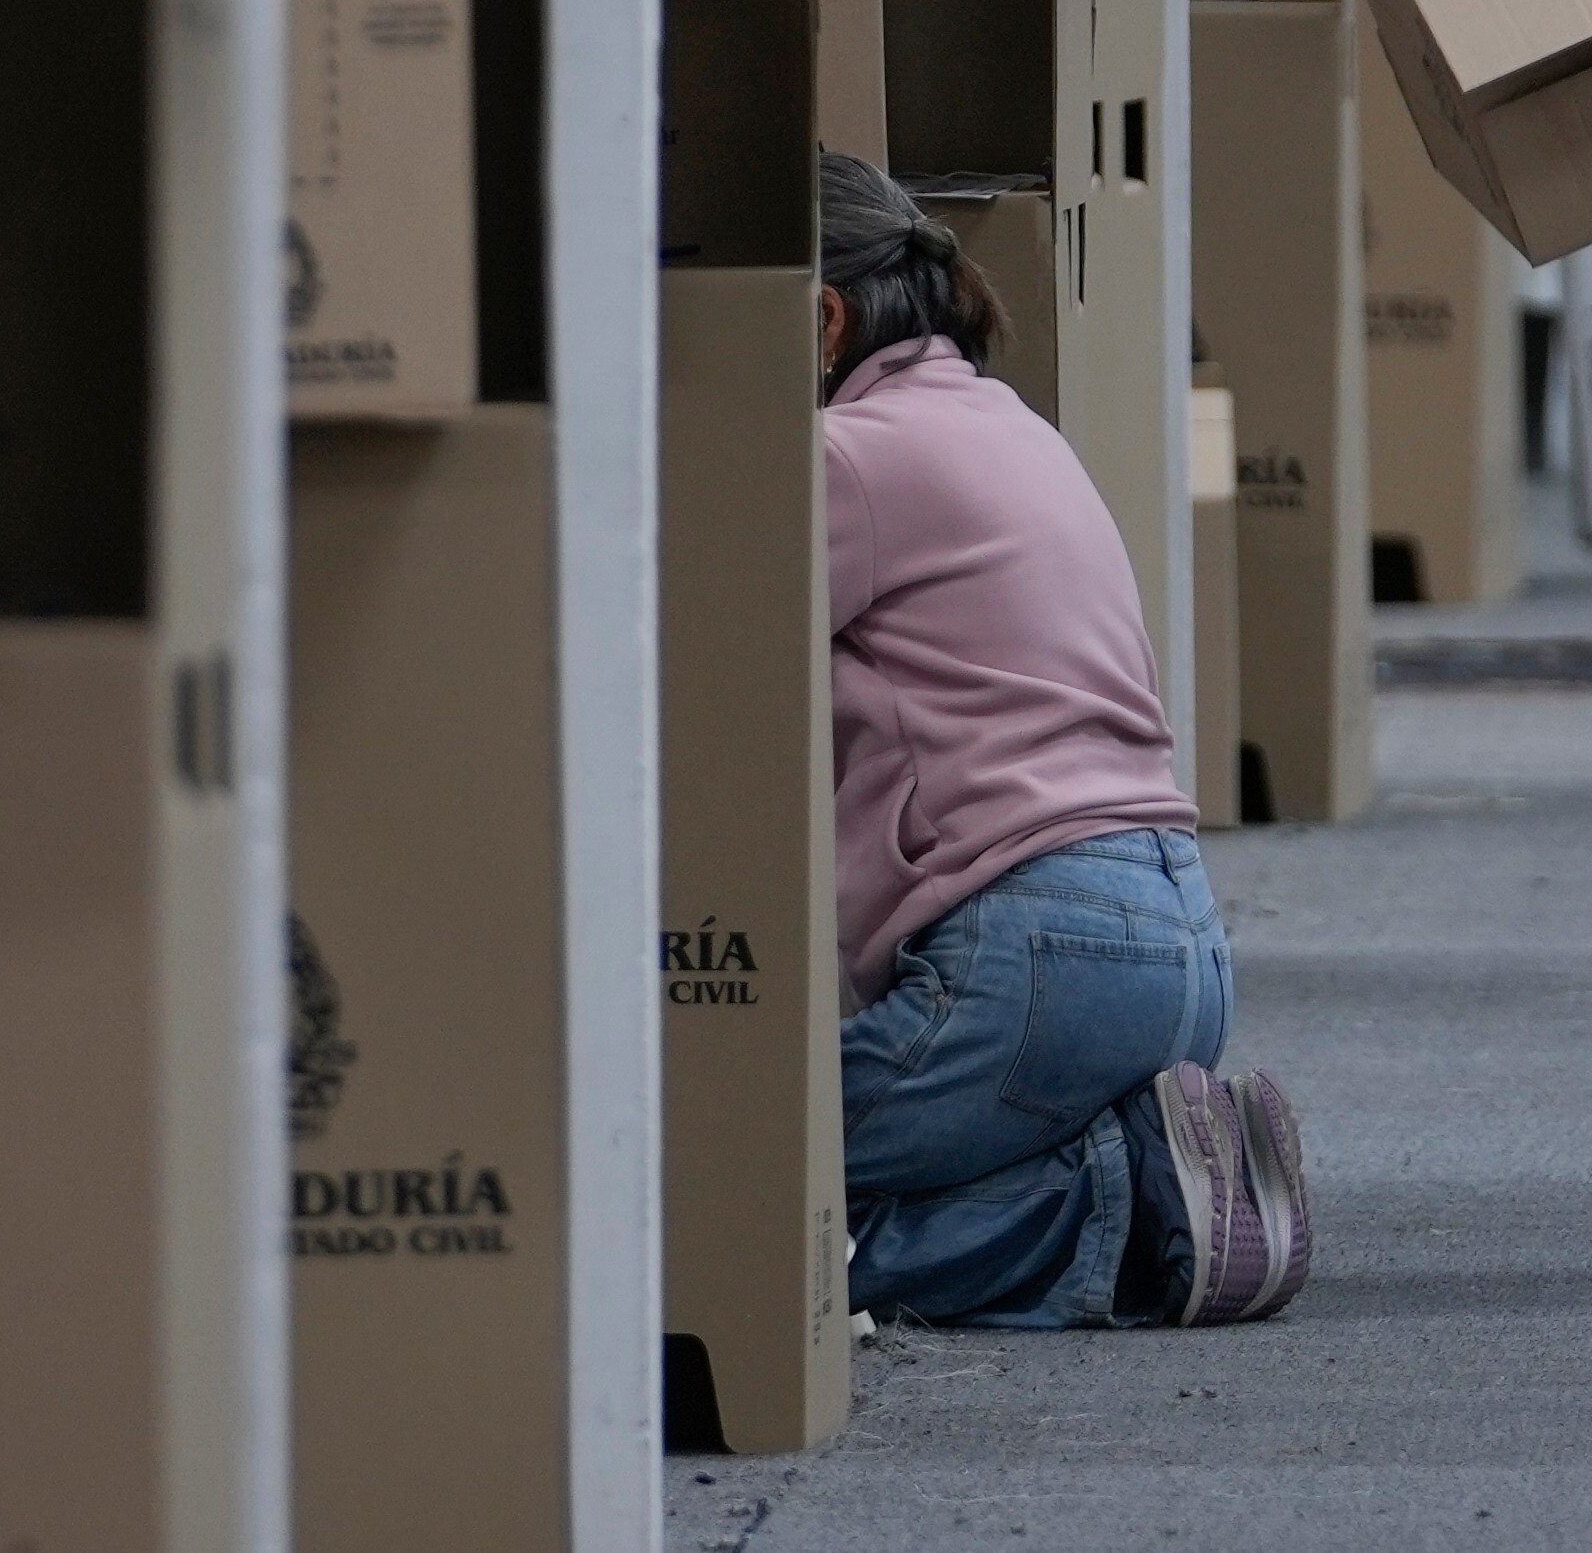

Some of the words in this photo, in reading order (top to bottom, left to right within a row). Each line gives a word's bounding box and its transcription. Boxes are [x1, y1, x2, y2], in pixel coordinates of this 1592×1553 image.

[659, 915, 760, 972] RÍA
[668, 980, 760, 1005] CIVIL
[290, 1148, 514, 1218] DURÍA
